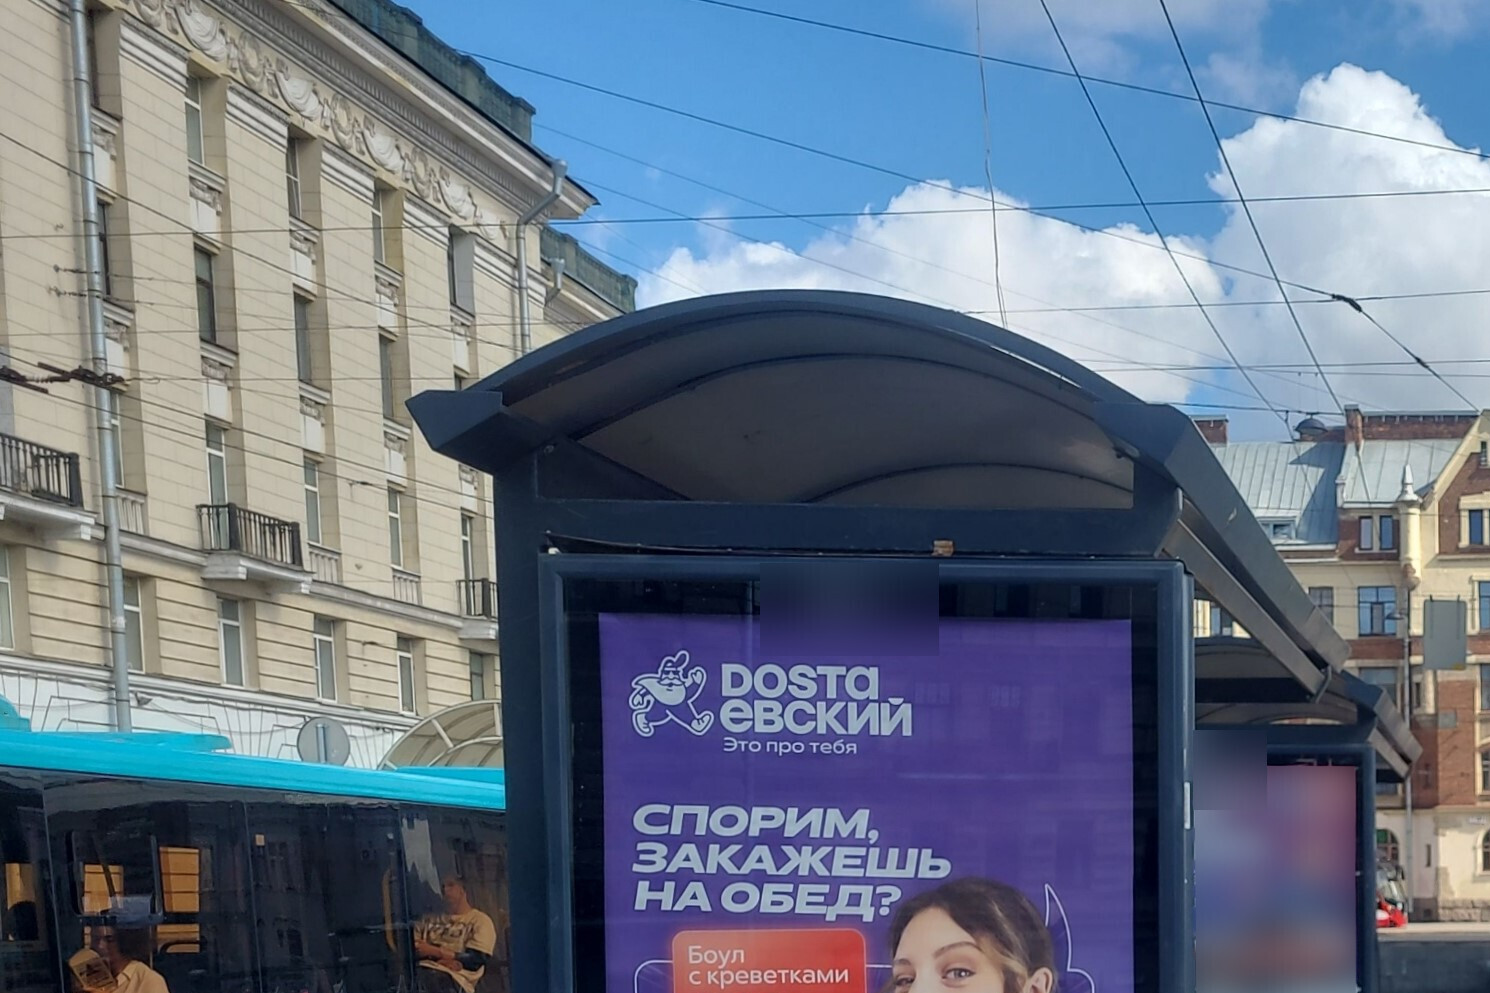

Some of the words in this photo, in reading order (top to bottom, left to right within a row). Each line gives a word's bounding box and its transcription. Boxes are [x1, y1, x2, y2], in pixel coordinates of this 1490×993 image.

[723, 737, 761, 752] Это
[766, 739, 805, 756] про
[809, 738, 857, 754] тебя
[632, 804, 879, 845] СПОРИМ,
[632, 842, 952, 879] ЗАКАЖЕШЬ
[634, 880, 712, 912] НА
[720, 882, 902, 922] ОБЕД?
[688, 945, 745, 969] Боул
[688, 970, 702, 985] с
[707, 968, 849, 989] креветками
